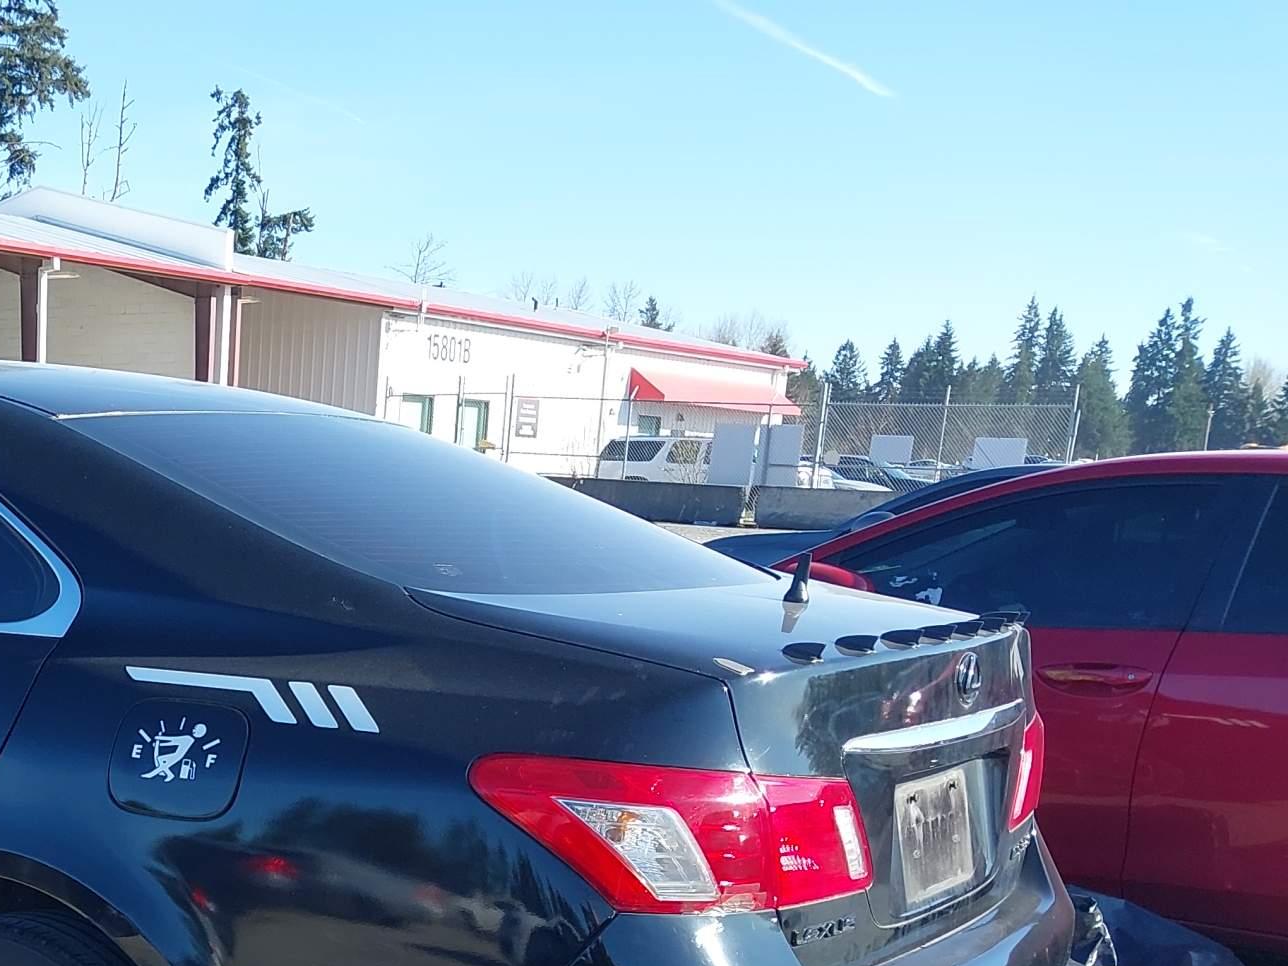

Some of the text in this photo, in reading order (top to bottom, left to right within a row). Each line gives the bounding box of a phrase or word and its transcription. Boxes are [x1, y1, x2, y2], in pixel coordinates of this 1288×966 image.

[427, 334, 472, 364] 15801B
[131, 744, 143, 759] E
[205, 754, 218, 768] F
